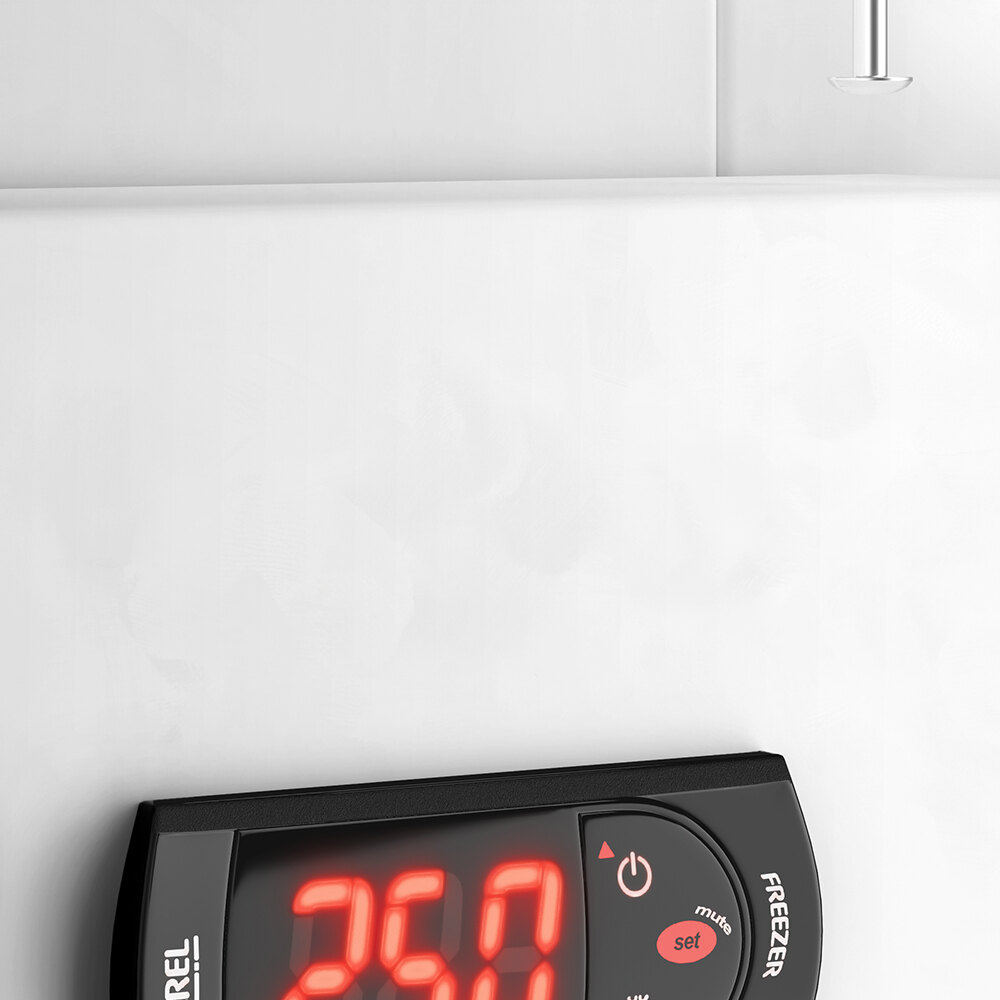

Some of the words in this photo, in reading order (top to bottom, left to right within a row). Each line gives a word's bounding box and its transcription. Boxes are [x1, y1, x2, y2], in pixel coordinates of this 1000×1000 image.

[694, 904, 732, 936] mute
[760, 872, 789, 979] FREEZER
[673, 931, 701, 951] set
